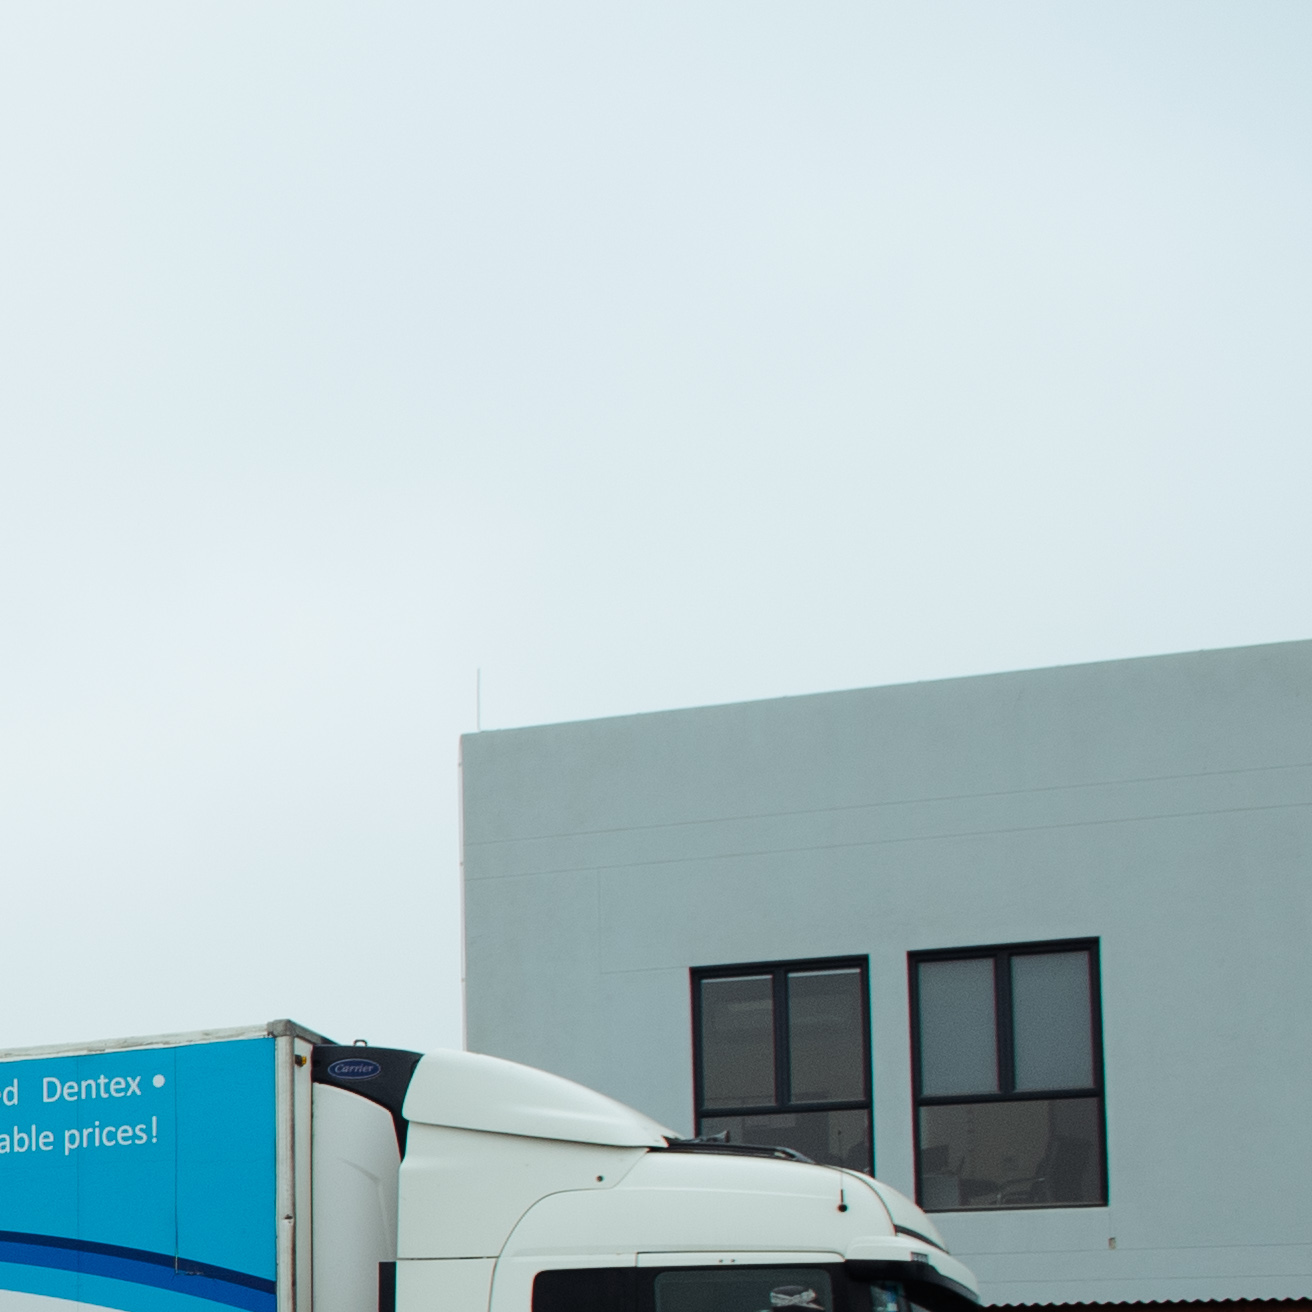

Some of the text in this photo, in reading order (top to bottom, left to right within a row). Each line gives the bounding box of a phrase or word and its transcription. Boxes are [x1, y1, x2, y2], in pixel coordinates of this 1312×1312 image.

[333, 1063, 374, 1074] Carrier
[42, 1073, 143, 1103] Dentex
[64, 1115, 158, 1156] prices!
